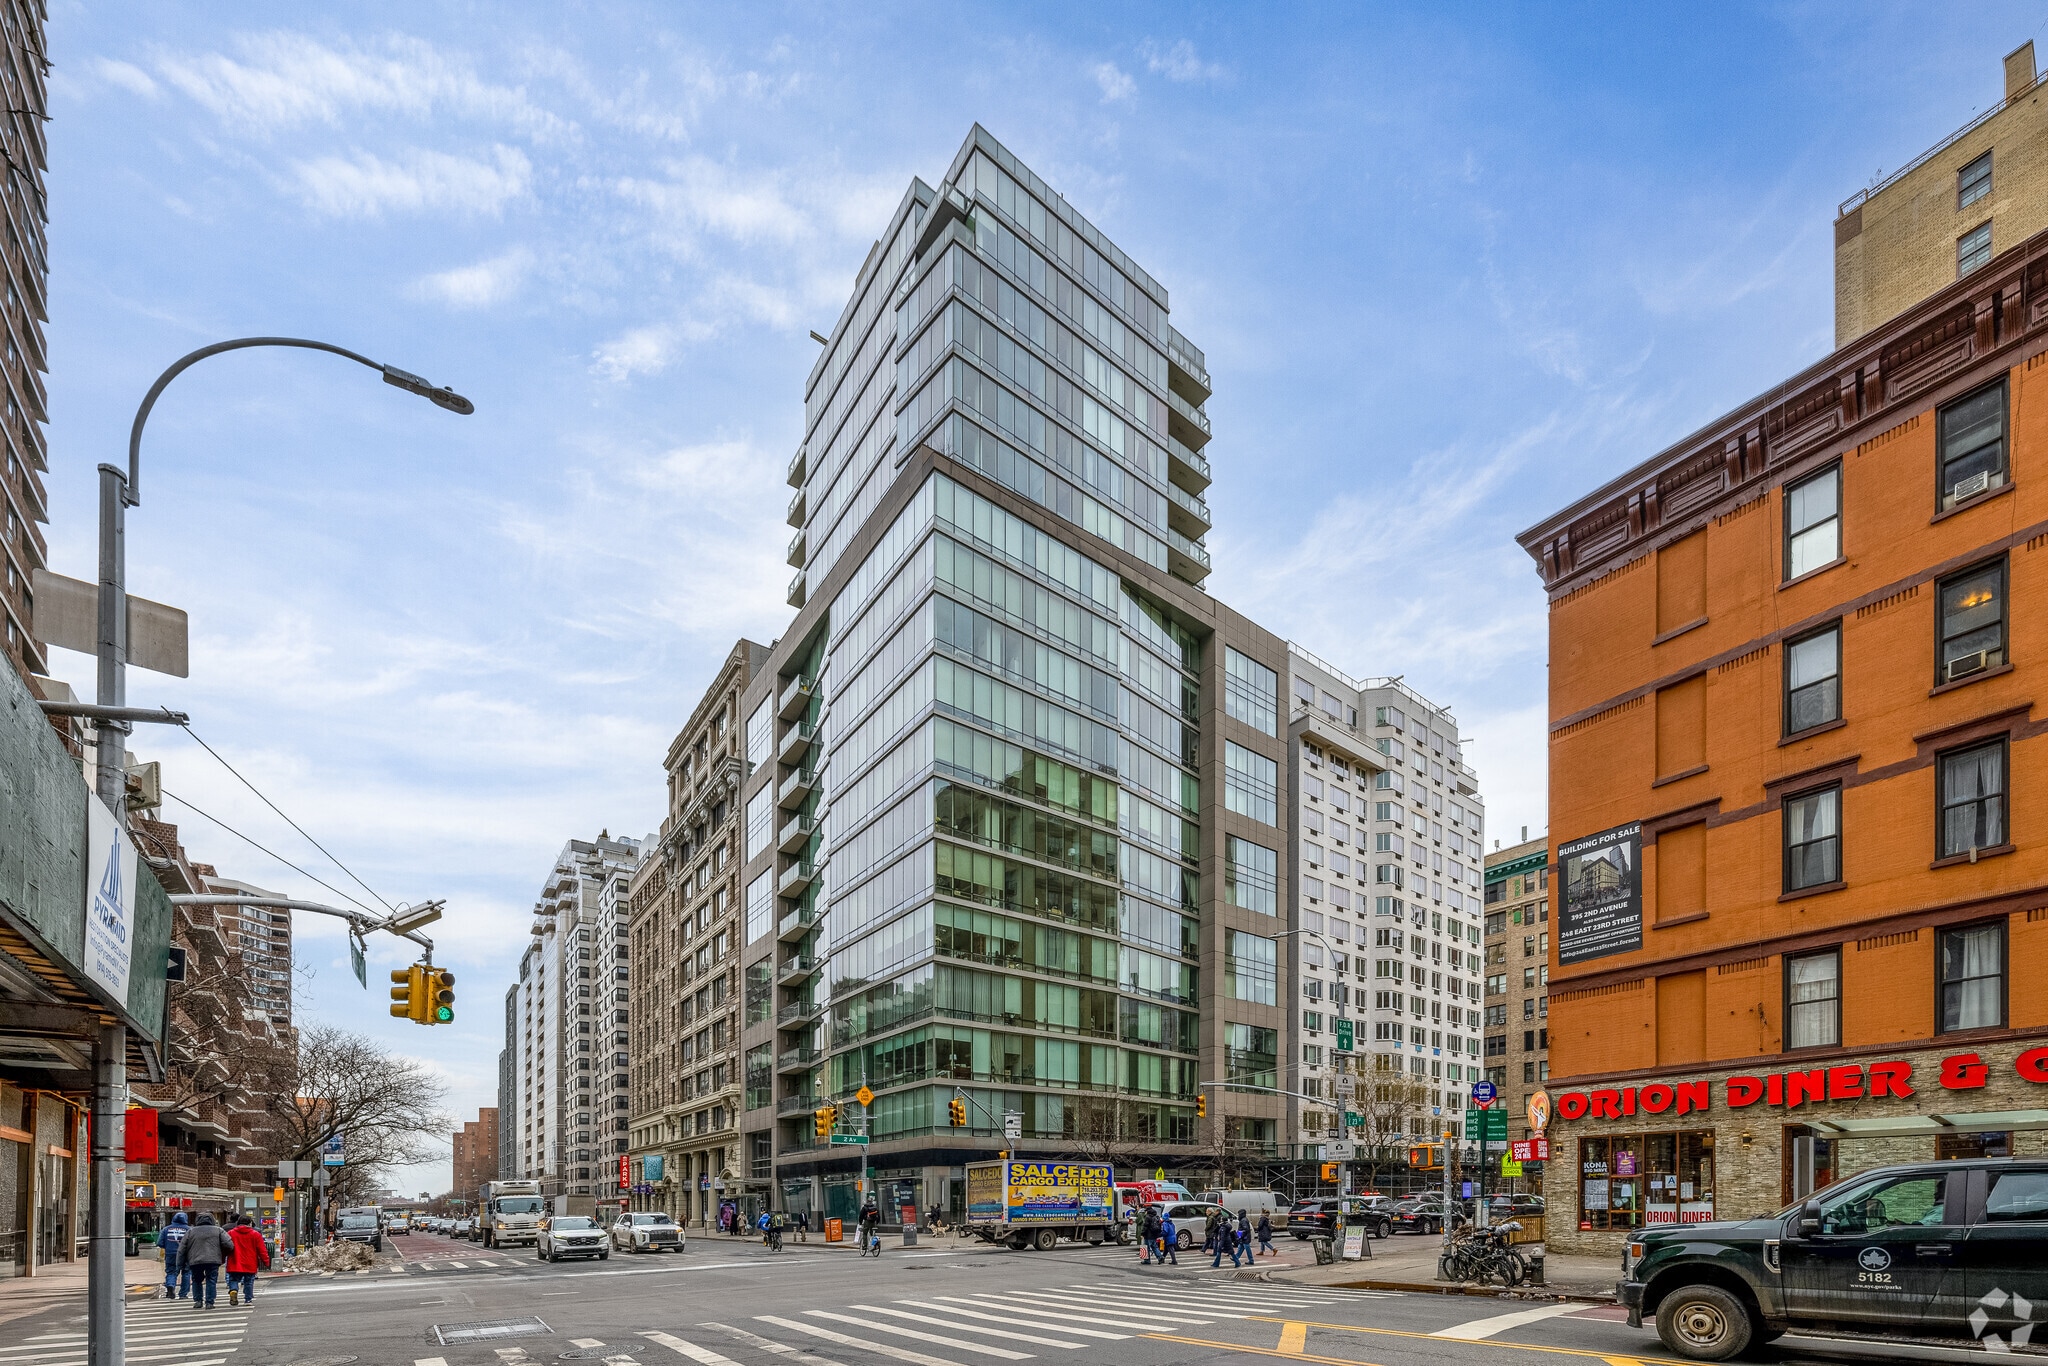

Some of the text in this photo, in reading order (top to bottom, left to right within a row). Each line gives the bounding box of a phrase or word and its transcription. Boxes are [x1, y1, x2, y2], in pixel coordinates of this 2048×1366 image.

[1559, 825, 1640, 856] BUILDING FOR SALE
[1584, 909, 1598, 918] 2ND
[1600, 901, 1628, 914] AVENUE
[1561, 914, 1640, 938] 248 EAST 23RD STREET
[1560, 926, 1640, 948] MIXED-USE DEVELOPMENT OPPORTUNITY
[1557, 1080, 1710, 1121] ORION
[1726, 1060, 1916, 1109] DINER
[1938, 1053, 1989, 1091] &
[1010, 1163, 1109, 1179] SALCEDO
[1583, 1161, 1608, 1169] KONA
[970, 1166, 1002, 1181] SALCEDO
[1010, 1176, 1109, 1187] CARGO EXPRESS
[1646, 1211, 1712, 1223] ORION DINER
[1858, 1272, 1892, 1283] 5182
